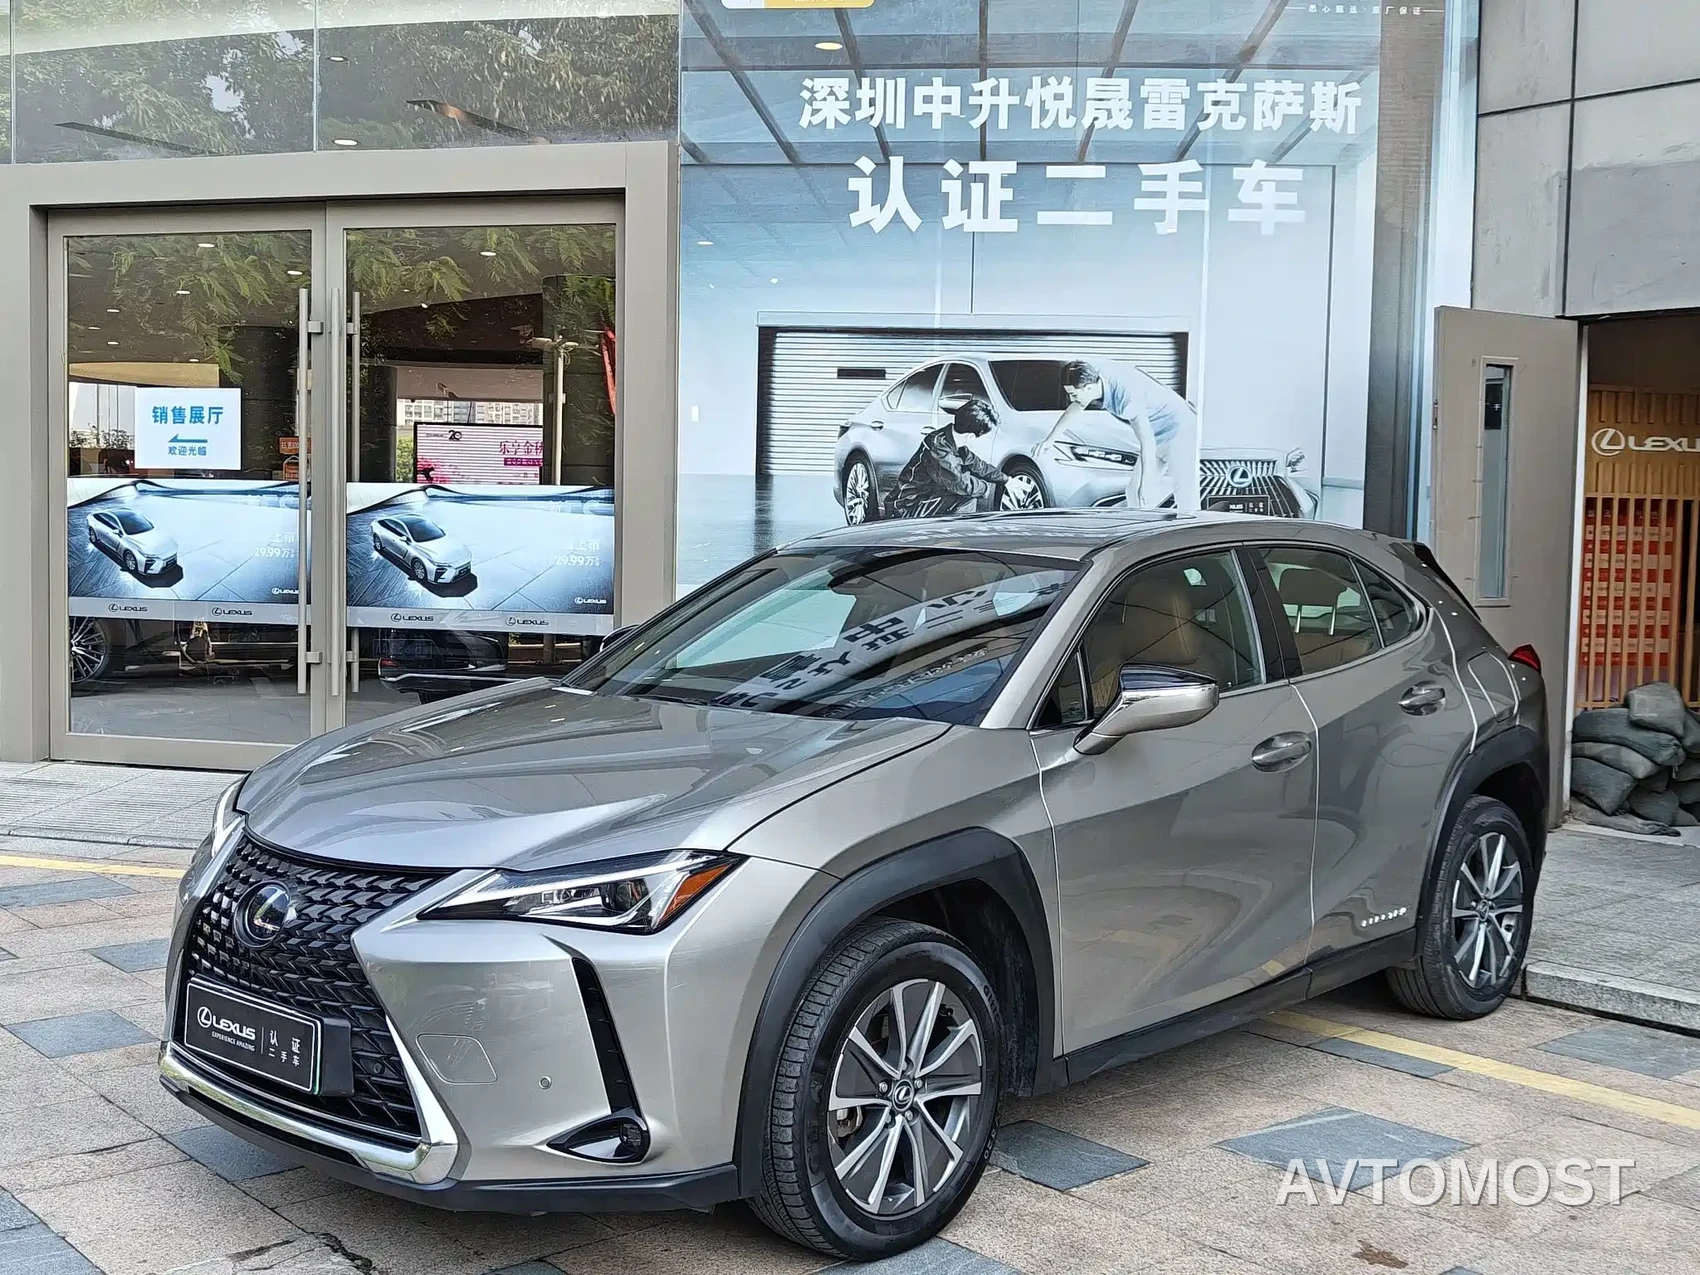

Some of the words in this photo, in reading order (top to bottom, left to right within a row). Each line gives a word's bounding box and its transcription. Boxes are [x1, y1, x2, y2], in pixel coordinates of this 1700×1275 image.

[799, 75, 1362, 135] 深圳中升悦晟雷克萨斯
[848, 156, 1307, 236] 认证二手车
[152, 406, 224, 425] 销售展厅
[168, 446, 207, 456] 欢迎光临
[1628, 435, 1700, 452] LEXU
[212, 1015, 256, 1040] LEXUS
[211, 1031, 236, 1045] EXPERIENCE
[236, 1039, 256, 1052] AMAZING
